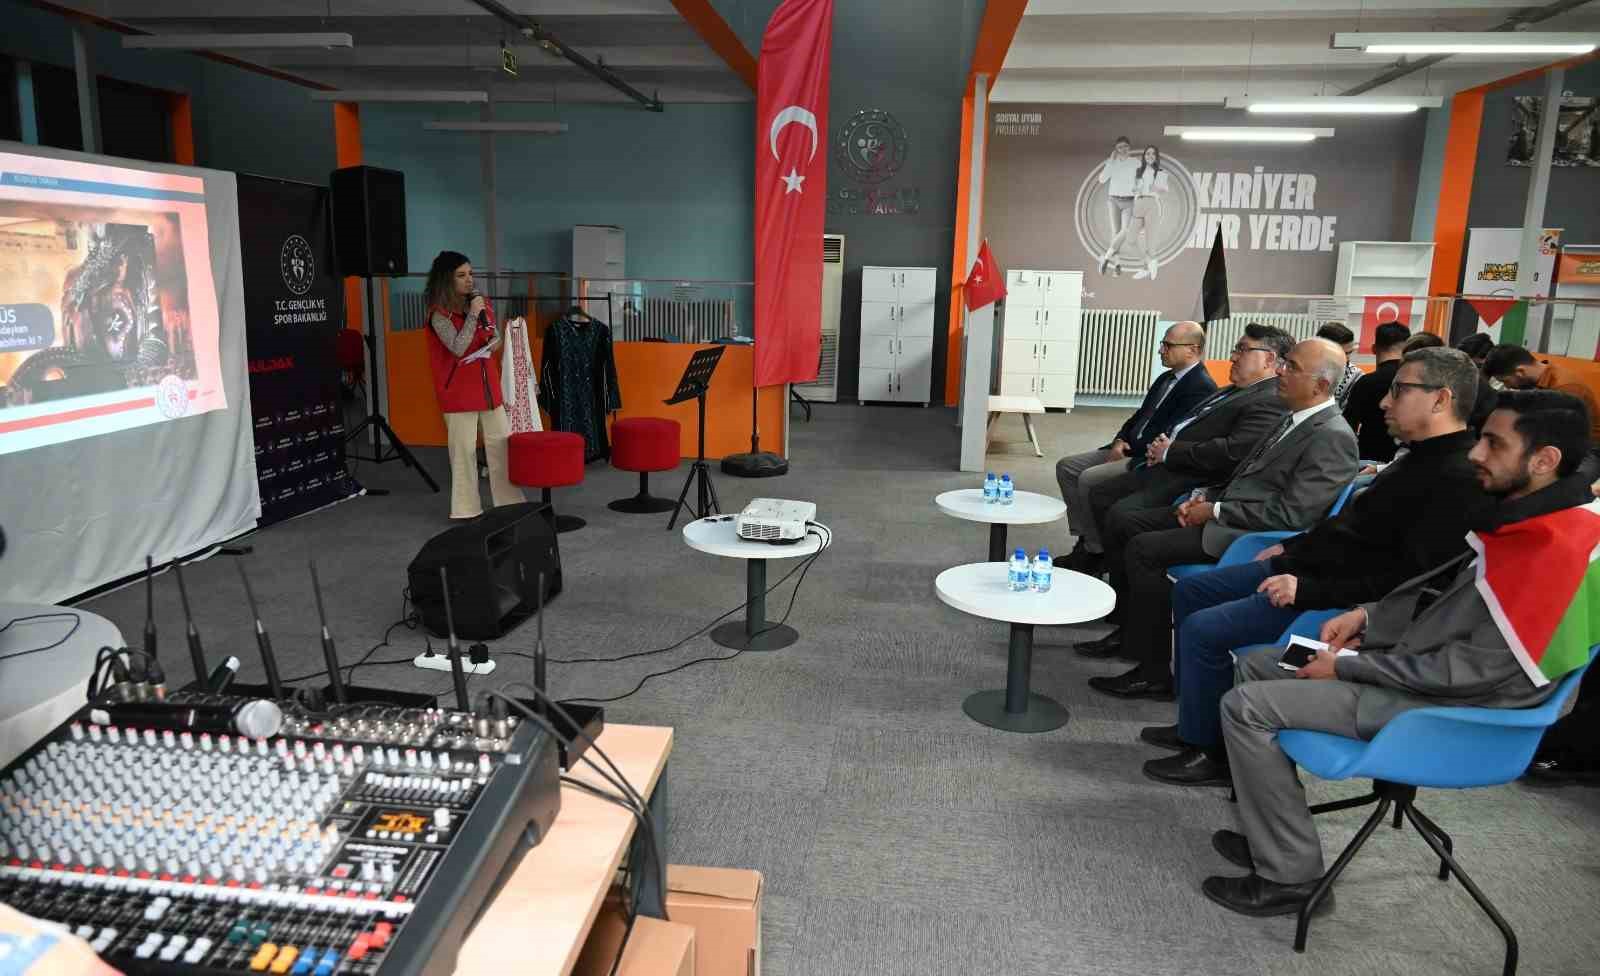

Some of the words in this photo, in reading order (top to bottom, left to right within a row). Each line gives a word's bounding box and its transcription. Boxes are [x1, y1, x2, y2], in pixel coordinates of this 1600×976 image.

[1192, 166, 1317, 210] KARİYER
[1249, 214, 1337, 251] YERDE
[275, 300, 288, 311] T.C.
[316, 299, 325, 309] VE
[274, 314, 293, 325] SPOR
